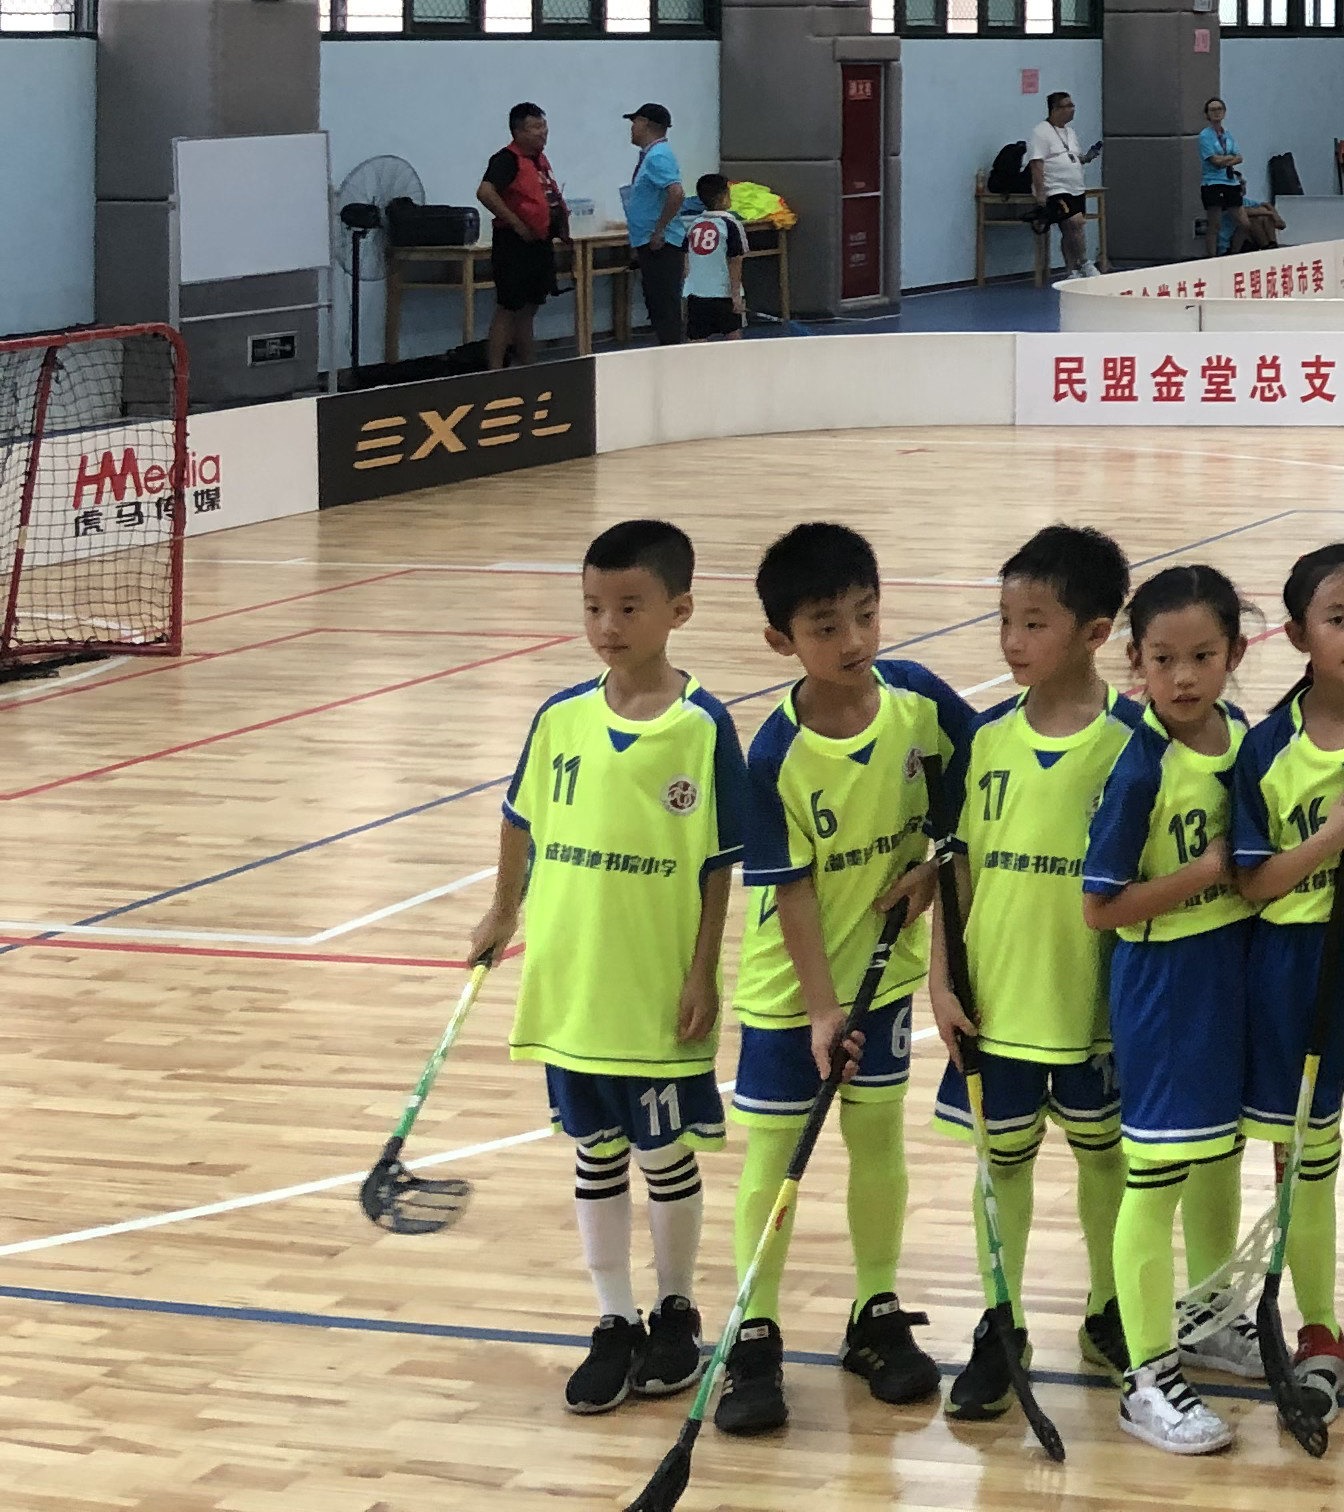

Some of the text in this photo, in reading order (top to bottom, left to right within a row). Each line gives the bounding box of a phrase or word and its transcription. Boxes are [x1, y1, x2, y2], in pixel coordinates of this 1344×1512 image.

[689, 224, 719, 252] 18
[1233, 259, 1324, 298] 民盟成都市委
[1053, 354, 1337, 404] 民盟金堂总支
[552, 752, 581, 807] 11
[978, 769, 1011, 821] 17
[810, 789, 839, 840] 6
[1168, 808, 1208, 864] 13
[640, 1082, 682, 1136] 11
